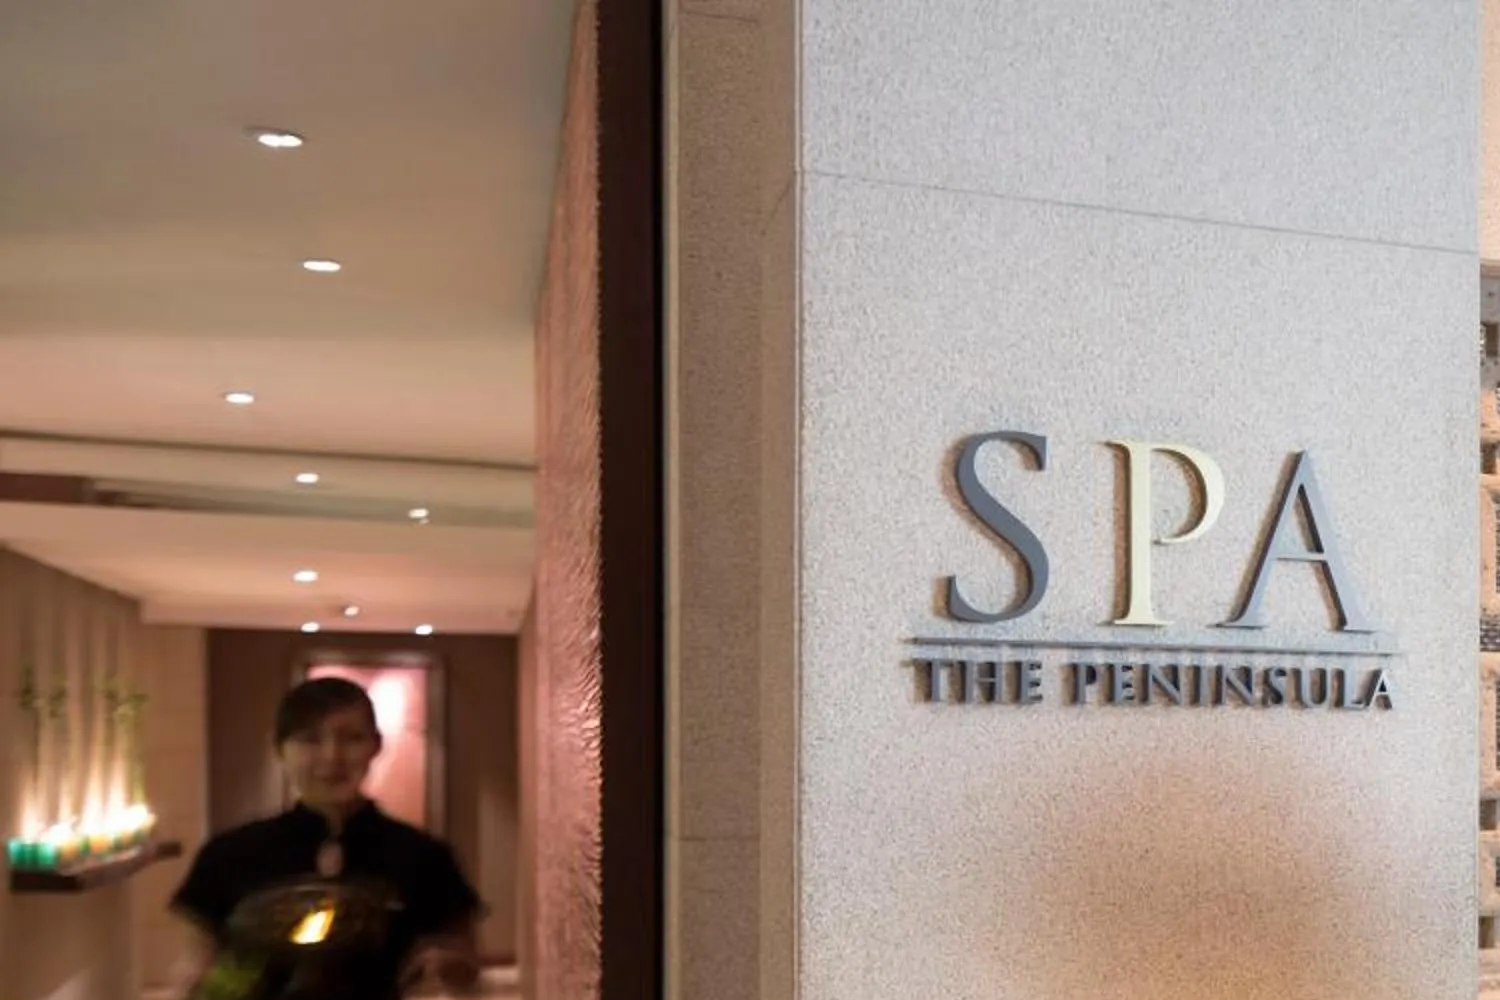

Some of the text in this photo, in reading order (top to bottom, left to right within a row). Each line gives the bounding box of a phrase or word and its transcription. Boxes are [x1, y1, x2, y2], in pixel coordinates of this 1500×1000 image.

[942, 430, 1378, 632] SPA
[910, 658, 1393, 709] THE PENINSULA
